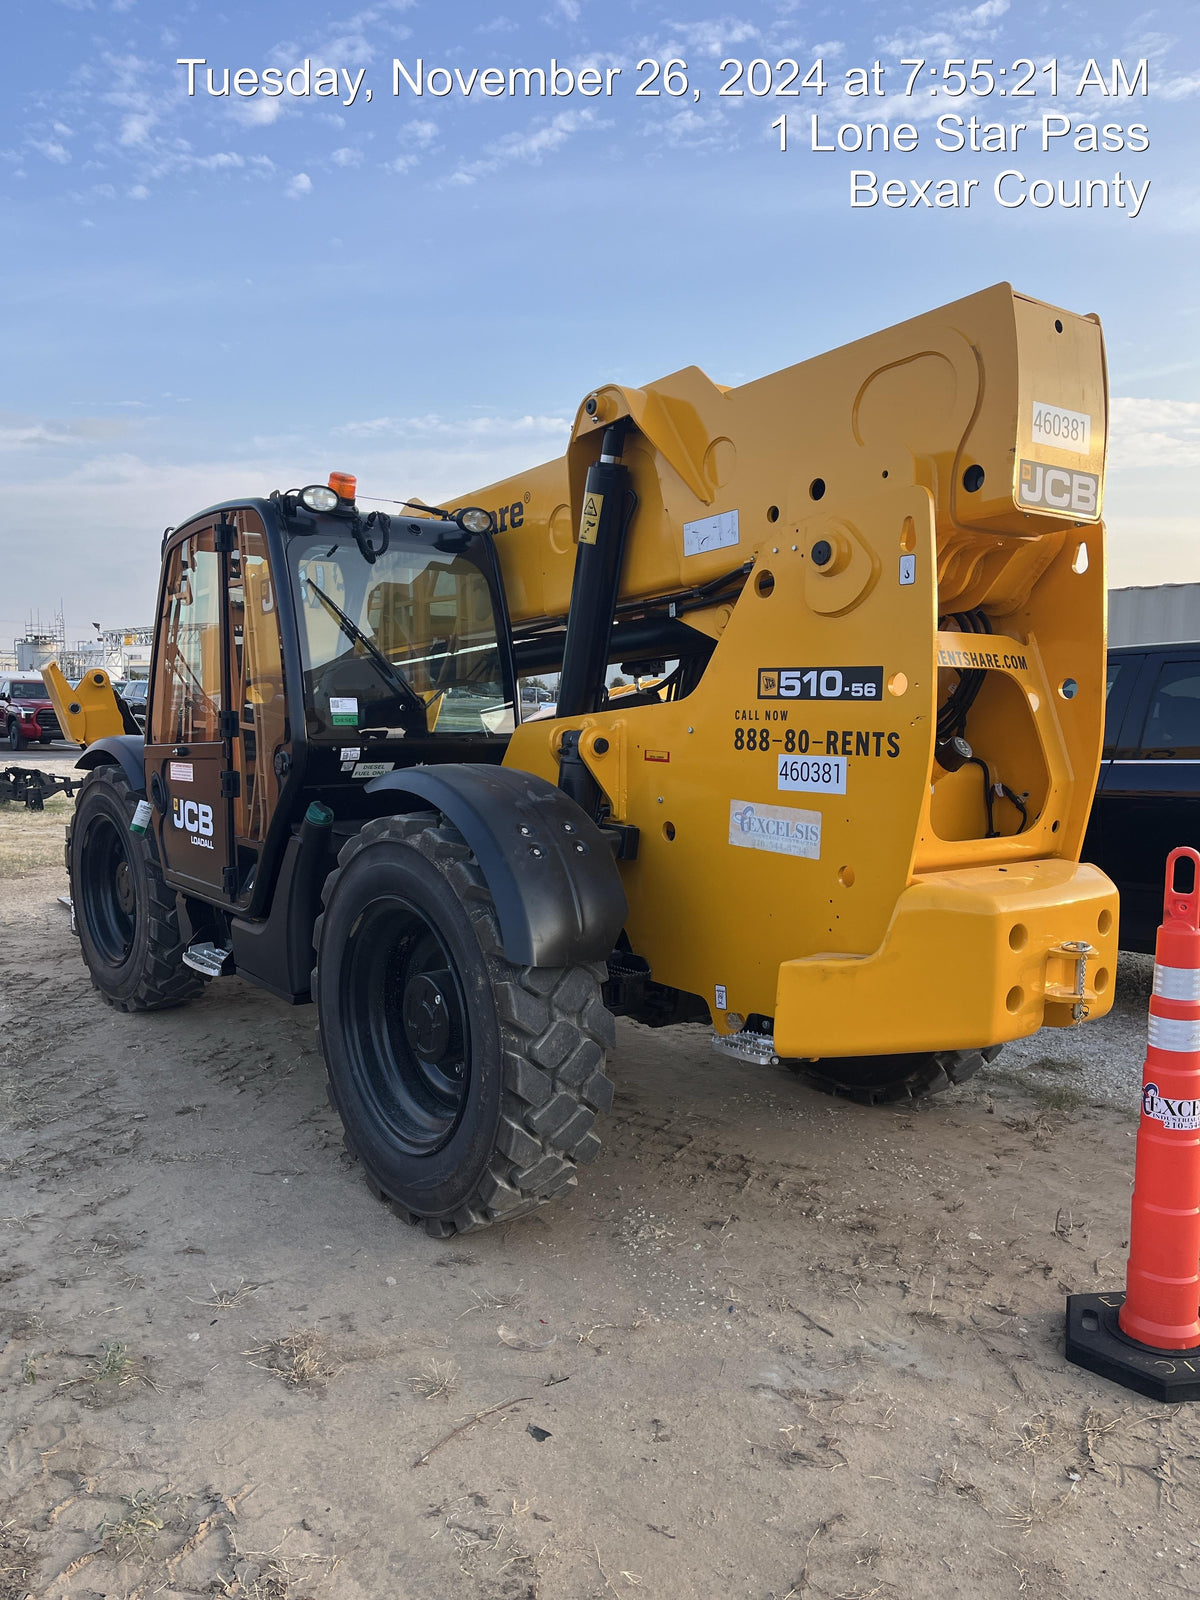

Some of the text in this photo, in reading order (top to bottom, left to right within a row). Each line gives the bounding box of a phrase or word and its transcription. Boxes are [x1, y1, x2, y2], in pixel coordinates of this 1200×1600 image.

[1033, 409, 1086, 443] 460381
[1021, 466, 1097, 512] JCB
[937, 649, 1028, 670] ENTSHARE.COM
[779, 670, 877, 697] 510-56
[734, 709, 789, 721] CALL NOW
[734, 727, 900, 758] 888-80-RENTS
[779, 761, 841, 785] 460381
[173, 798, 214, 837] JCB
[746, 816, 819, 842] EXCELSIS
[190, 835, 214, 850] LOADALL
